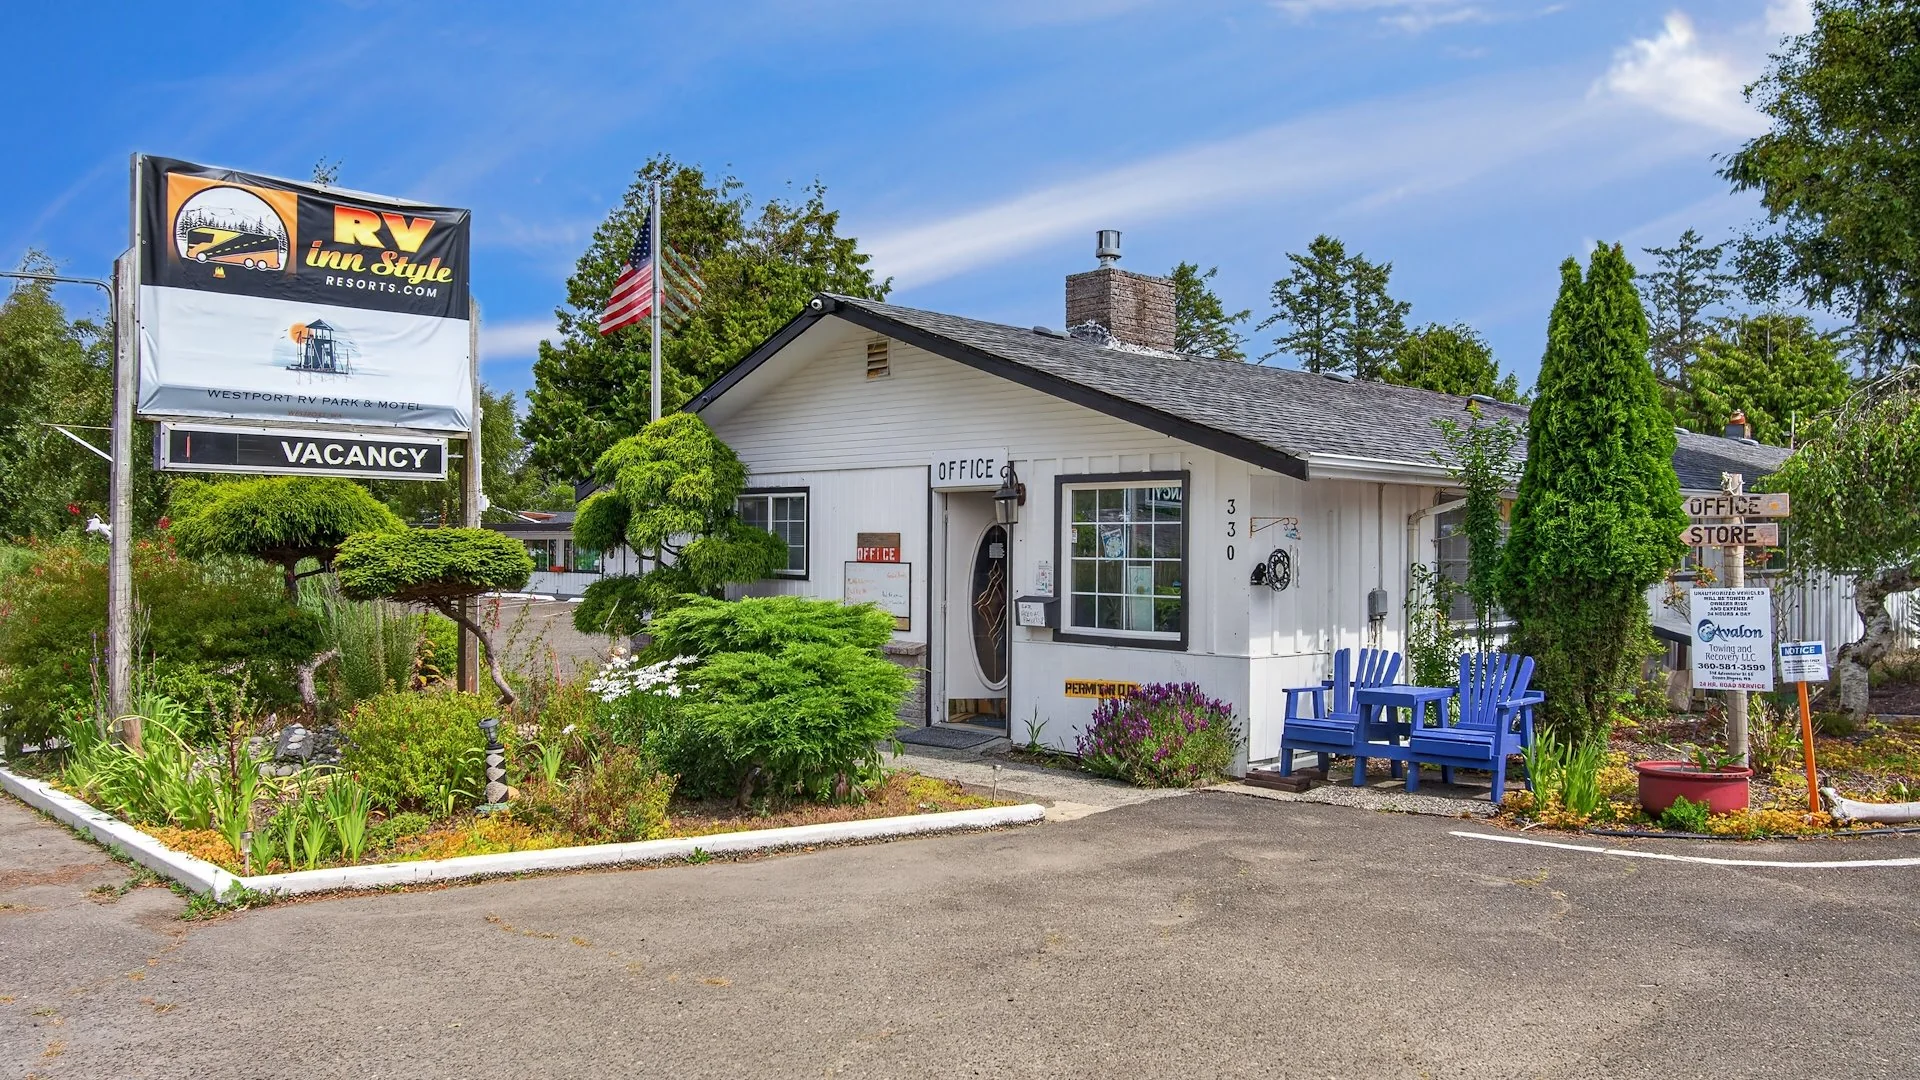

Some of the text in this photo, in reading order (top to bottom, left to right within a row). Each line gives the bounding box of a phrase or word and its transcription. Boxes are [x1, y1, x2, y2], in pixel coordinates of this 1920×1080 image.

[333, 204, 436, 253] RV
[305, 240, 453, 285] inn Style
[325, 275, 438, 298] RESORTS.COM
[207, 389, 424, 411] WESTPORT RV PARK & MOTEL
[280, 440, 429, 469] VACANCY
[938, 458, 994, 481] OFFICE
[1690, 496, 1761, 516] OFFICE
[1690, 526, 1757, 545] STORE
[857, 547, 895, 561] OFFICE
[1714, 624, 1764, 642] Avalon
[1705, 652, 1756, 663] Recovery LLC
[1709, 644, 1752, 654] Towing and
[1784, 646, 1815, 655] NOTICE
[1697, 662, 1766, 671] 360-581-3599
